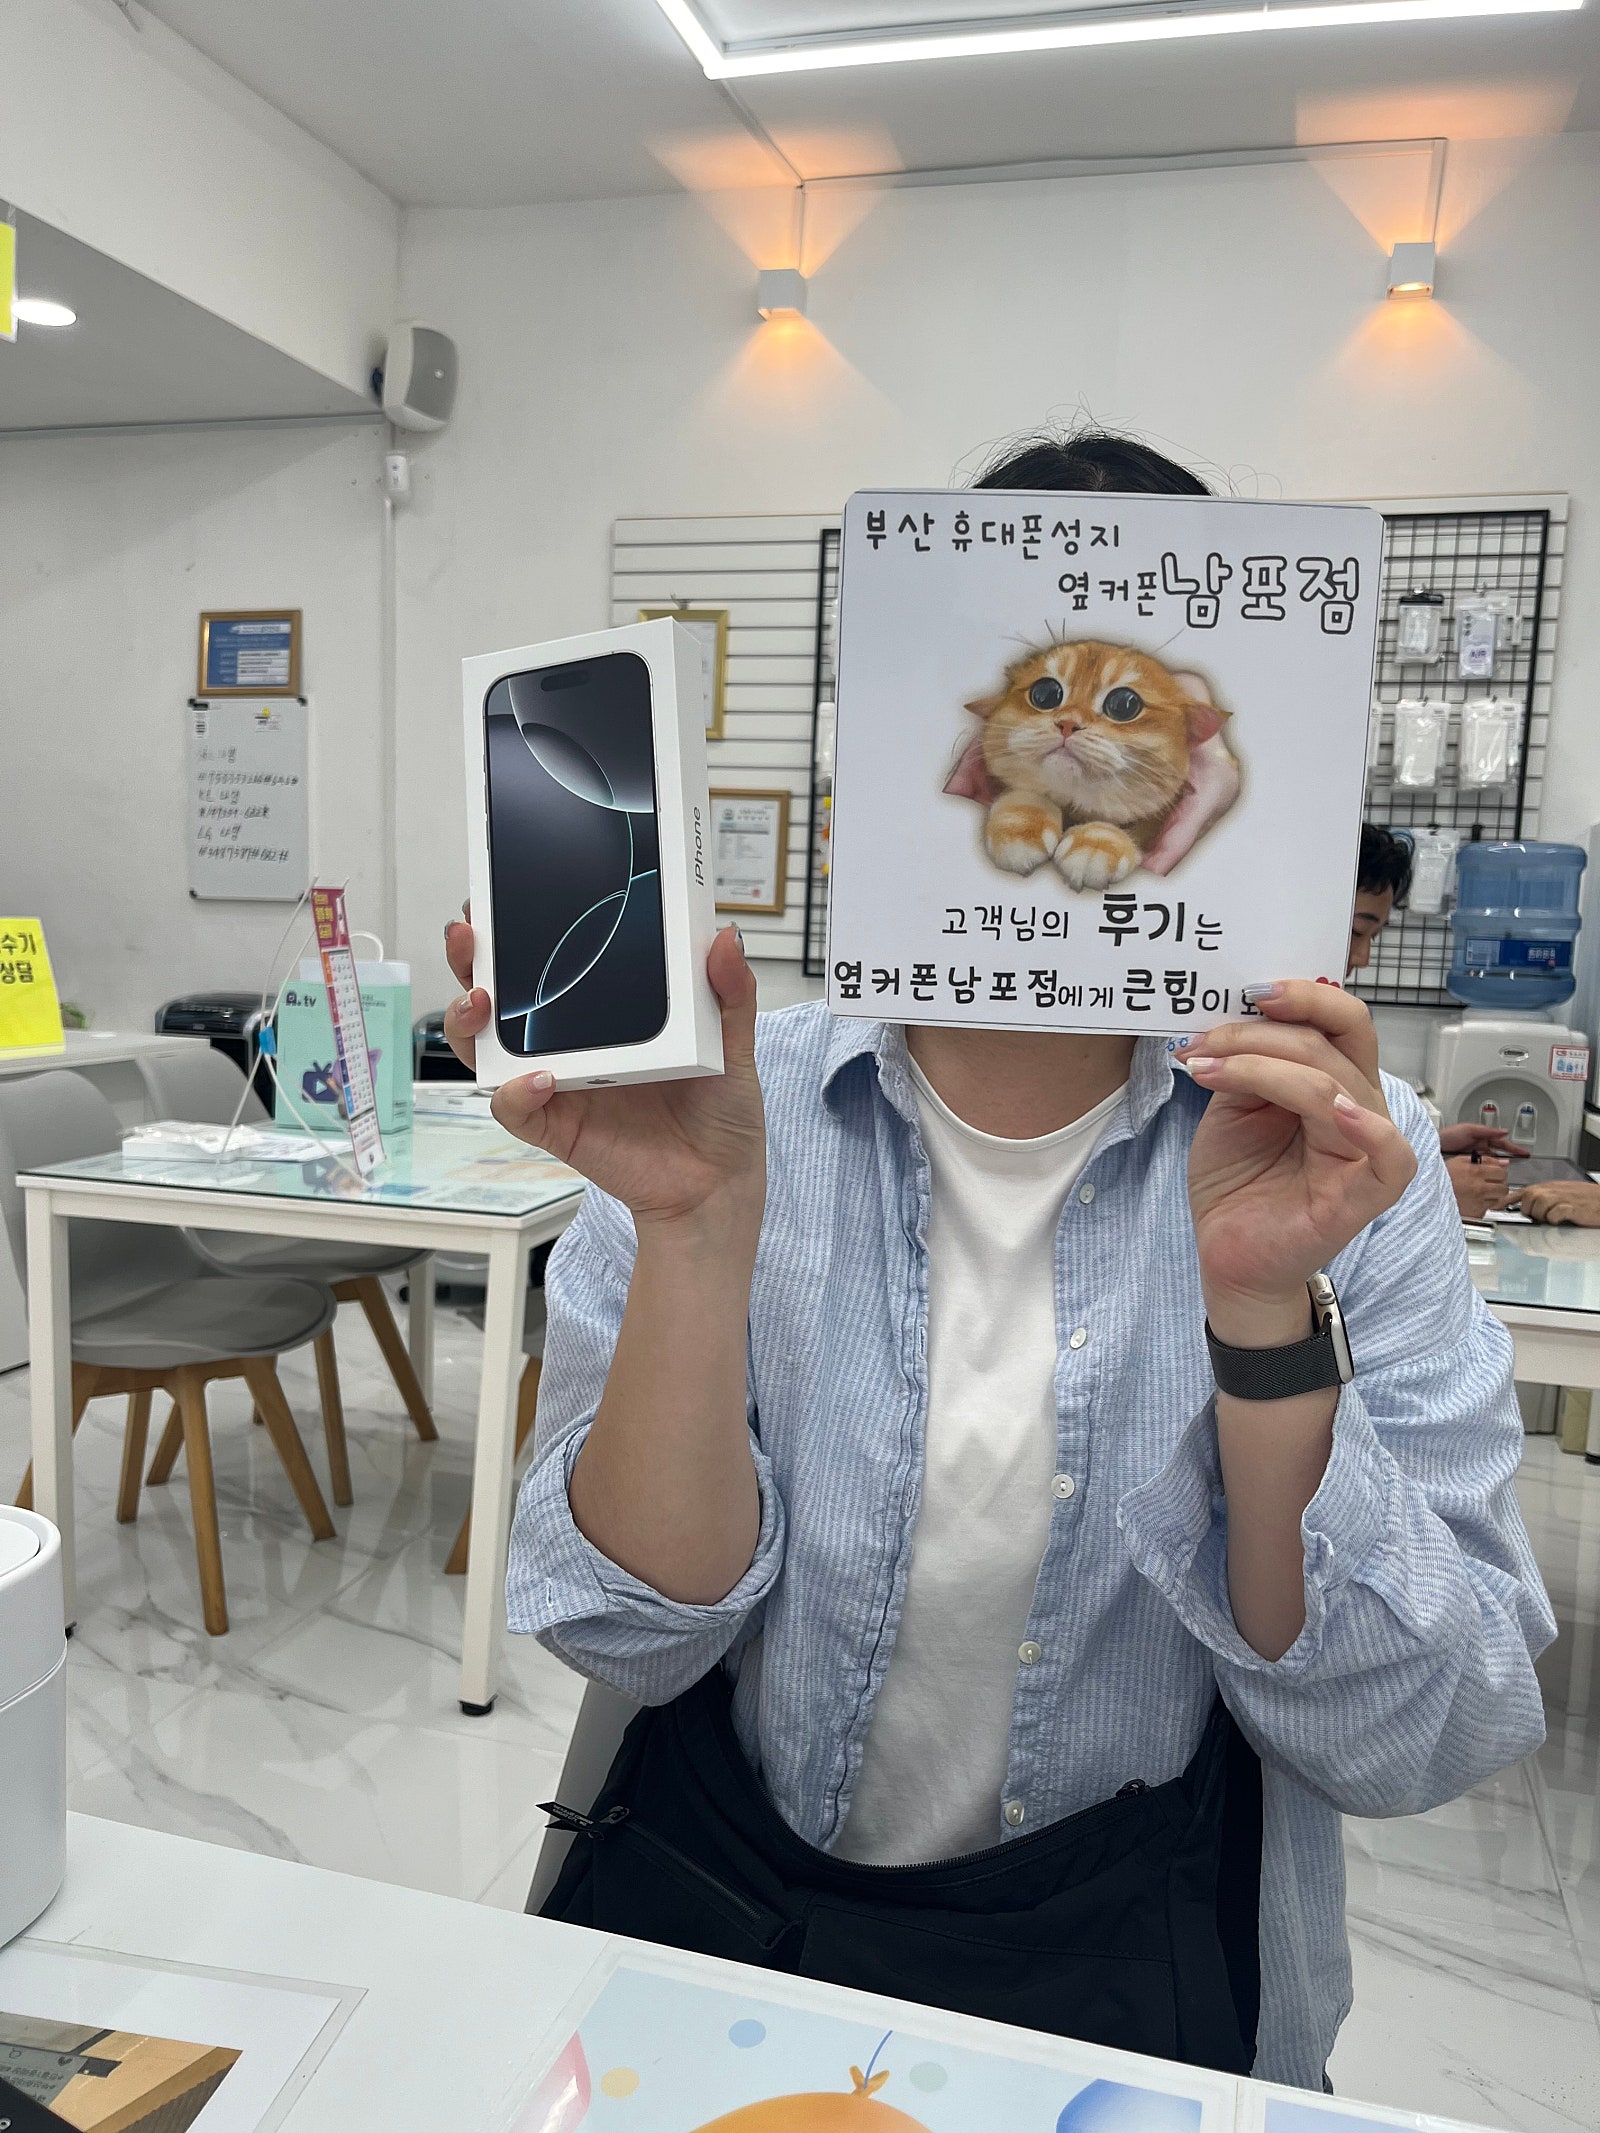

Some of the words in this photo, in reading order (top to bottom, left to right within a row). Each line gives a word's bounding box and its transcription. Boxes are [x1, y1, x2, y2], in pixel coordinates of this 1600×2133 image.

[866, 509, 935, 552] 부산
[951, 510, 1120, 560] 휴대폰성지
[1161, 552, 1360, 635] 남포점
[693, 806, 705, 887] iPhone
[0, 932, 36, 955] 수기
[942, 904, 1069, 942] 고객님의
[1098, 893, 1223, 951] 후기는
[0, 962, 34, 985] 상담
